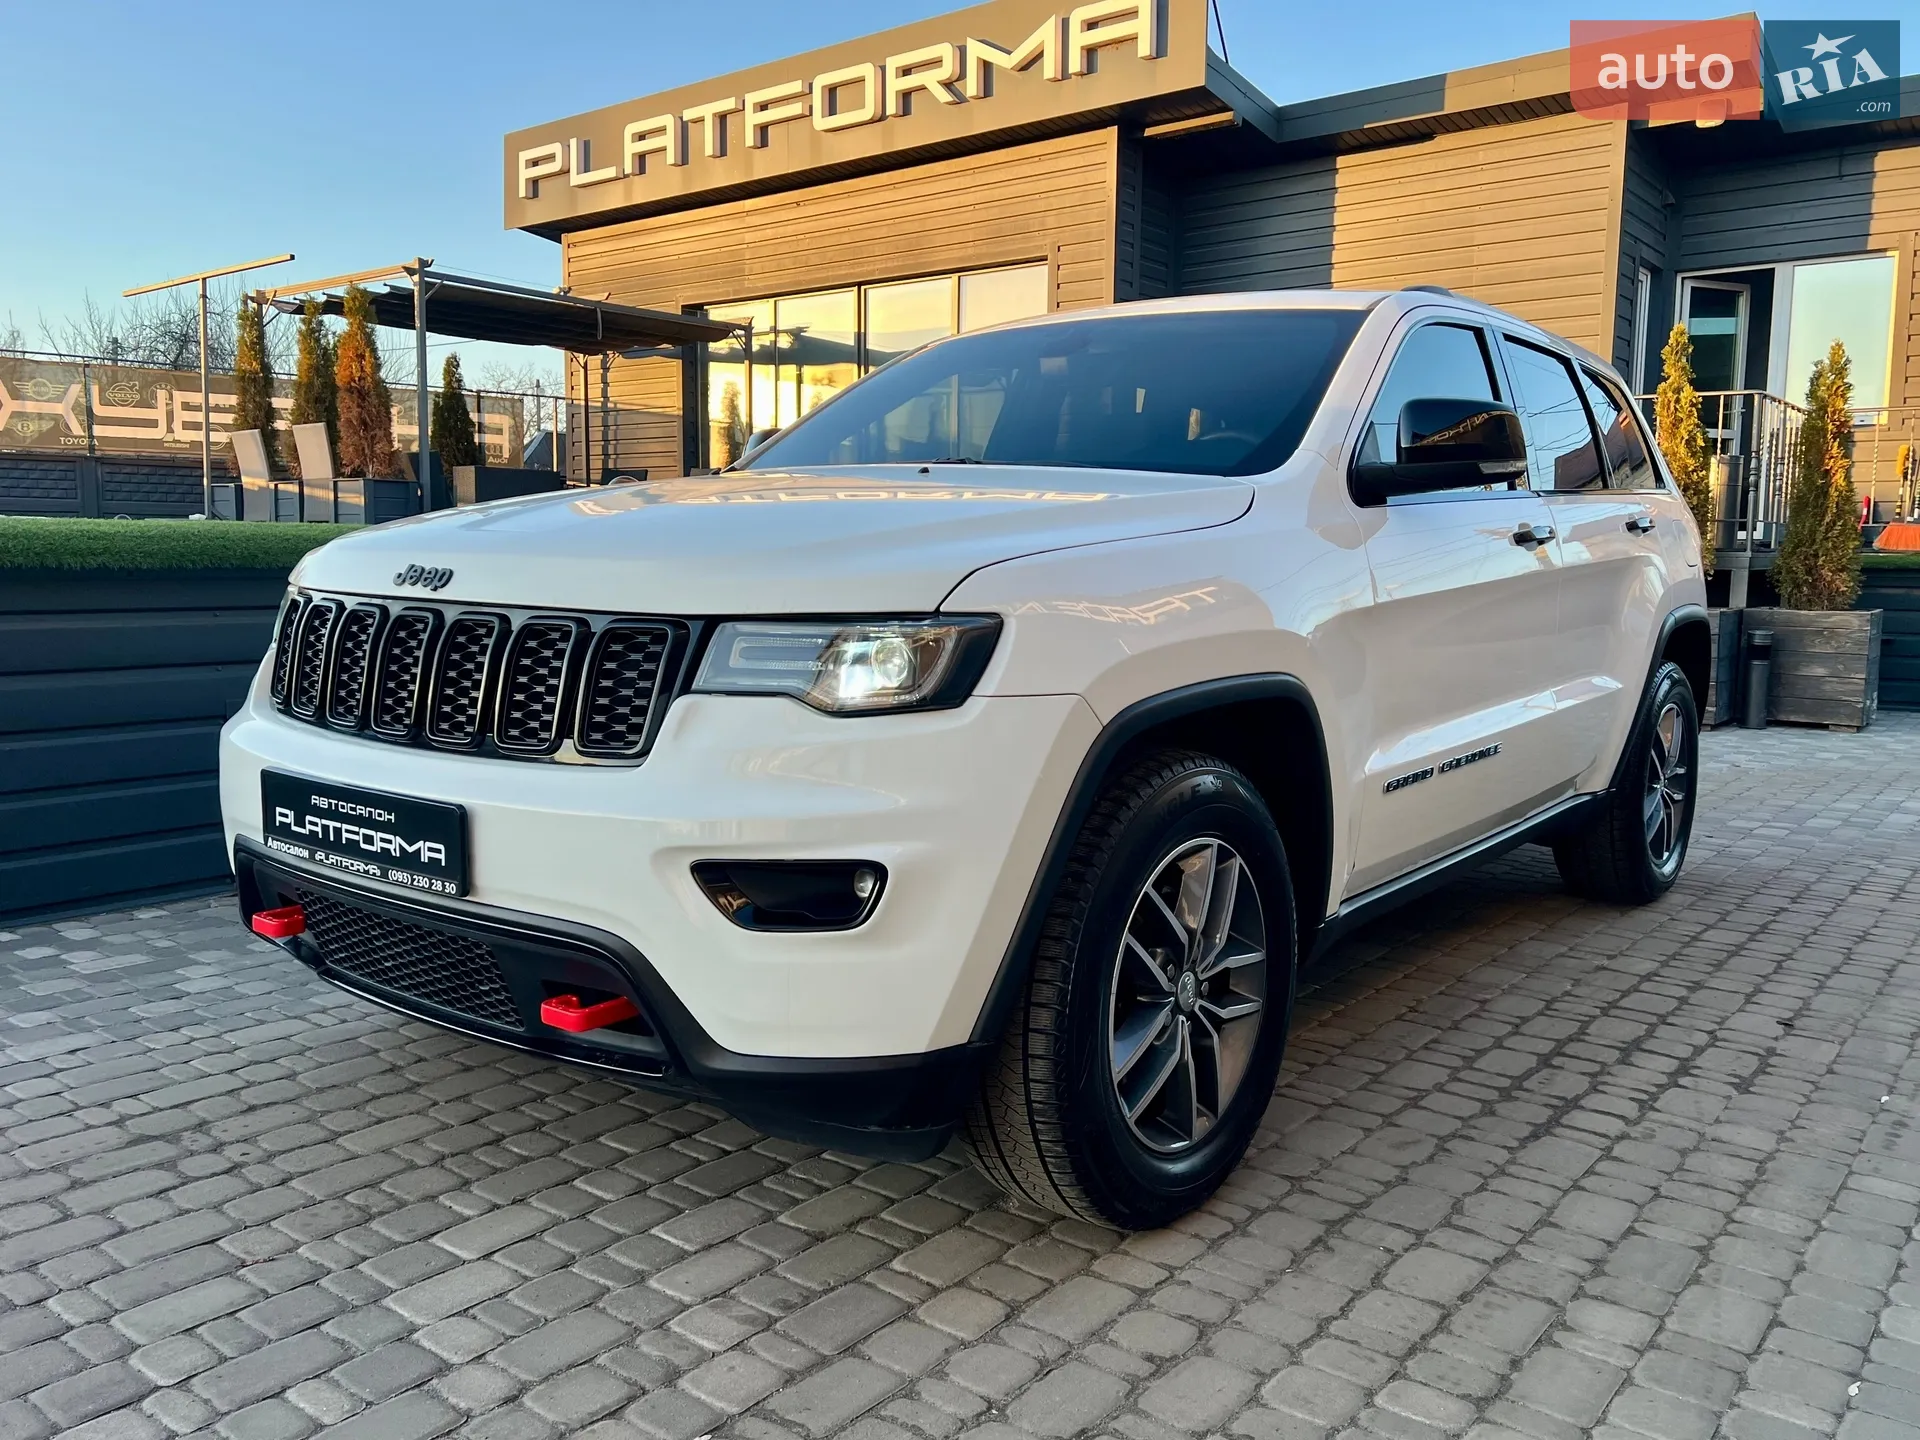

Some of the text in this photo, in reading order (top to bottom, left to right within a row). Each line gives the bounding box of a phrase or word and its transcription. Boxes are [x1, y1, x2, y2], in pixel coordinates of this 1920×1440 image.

[518, 0, 1157, 198] PLATFORMA
[108, 391, 140, 400] VOLVO
[59, 436, 99, 446] TOYOTA
[393, 563, 454, 592] Jeep
[1383, 742, 1503, 794] GRAND CHEROKEE
[311, 795, 395, 823] АВТОСАЛОН
[275, 807, 446, 867] PLATFORMA
[267, 837, 309, 859] Автосалон
[388, 869, 412, 886] (093)
[413, 874, 430, 889] 230
[431, 878, 443, 892] 28
[444, 882, 457, 895] 30
